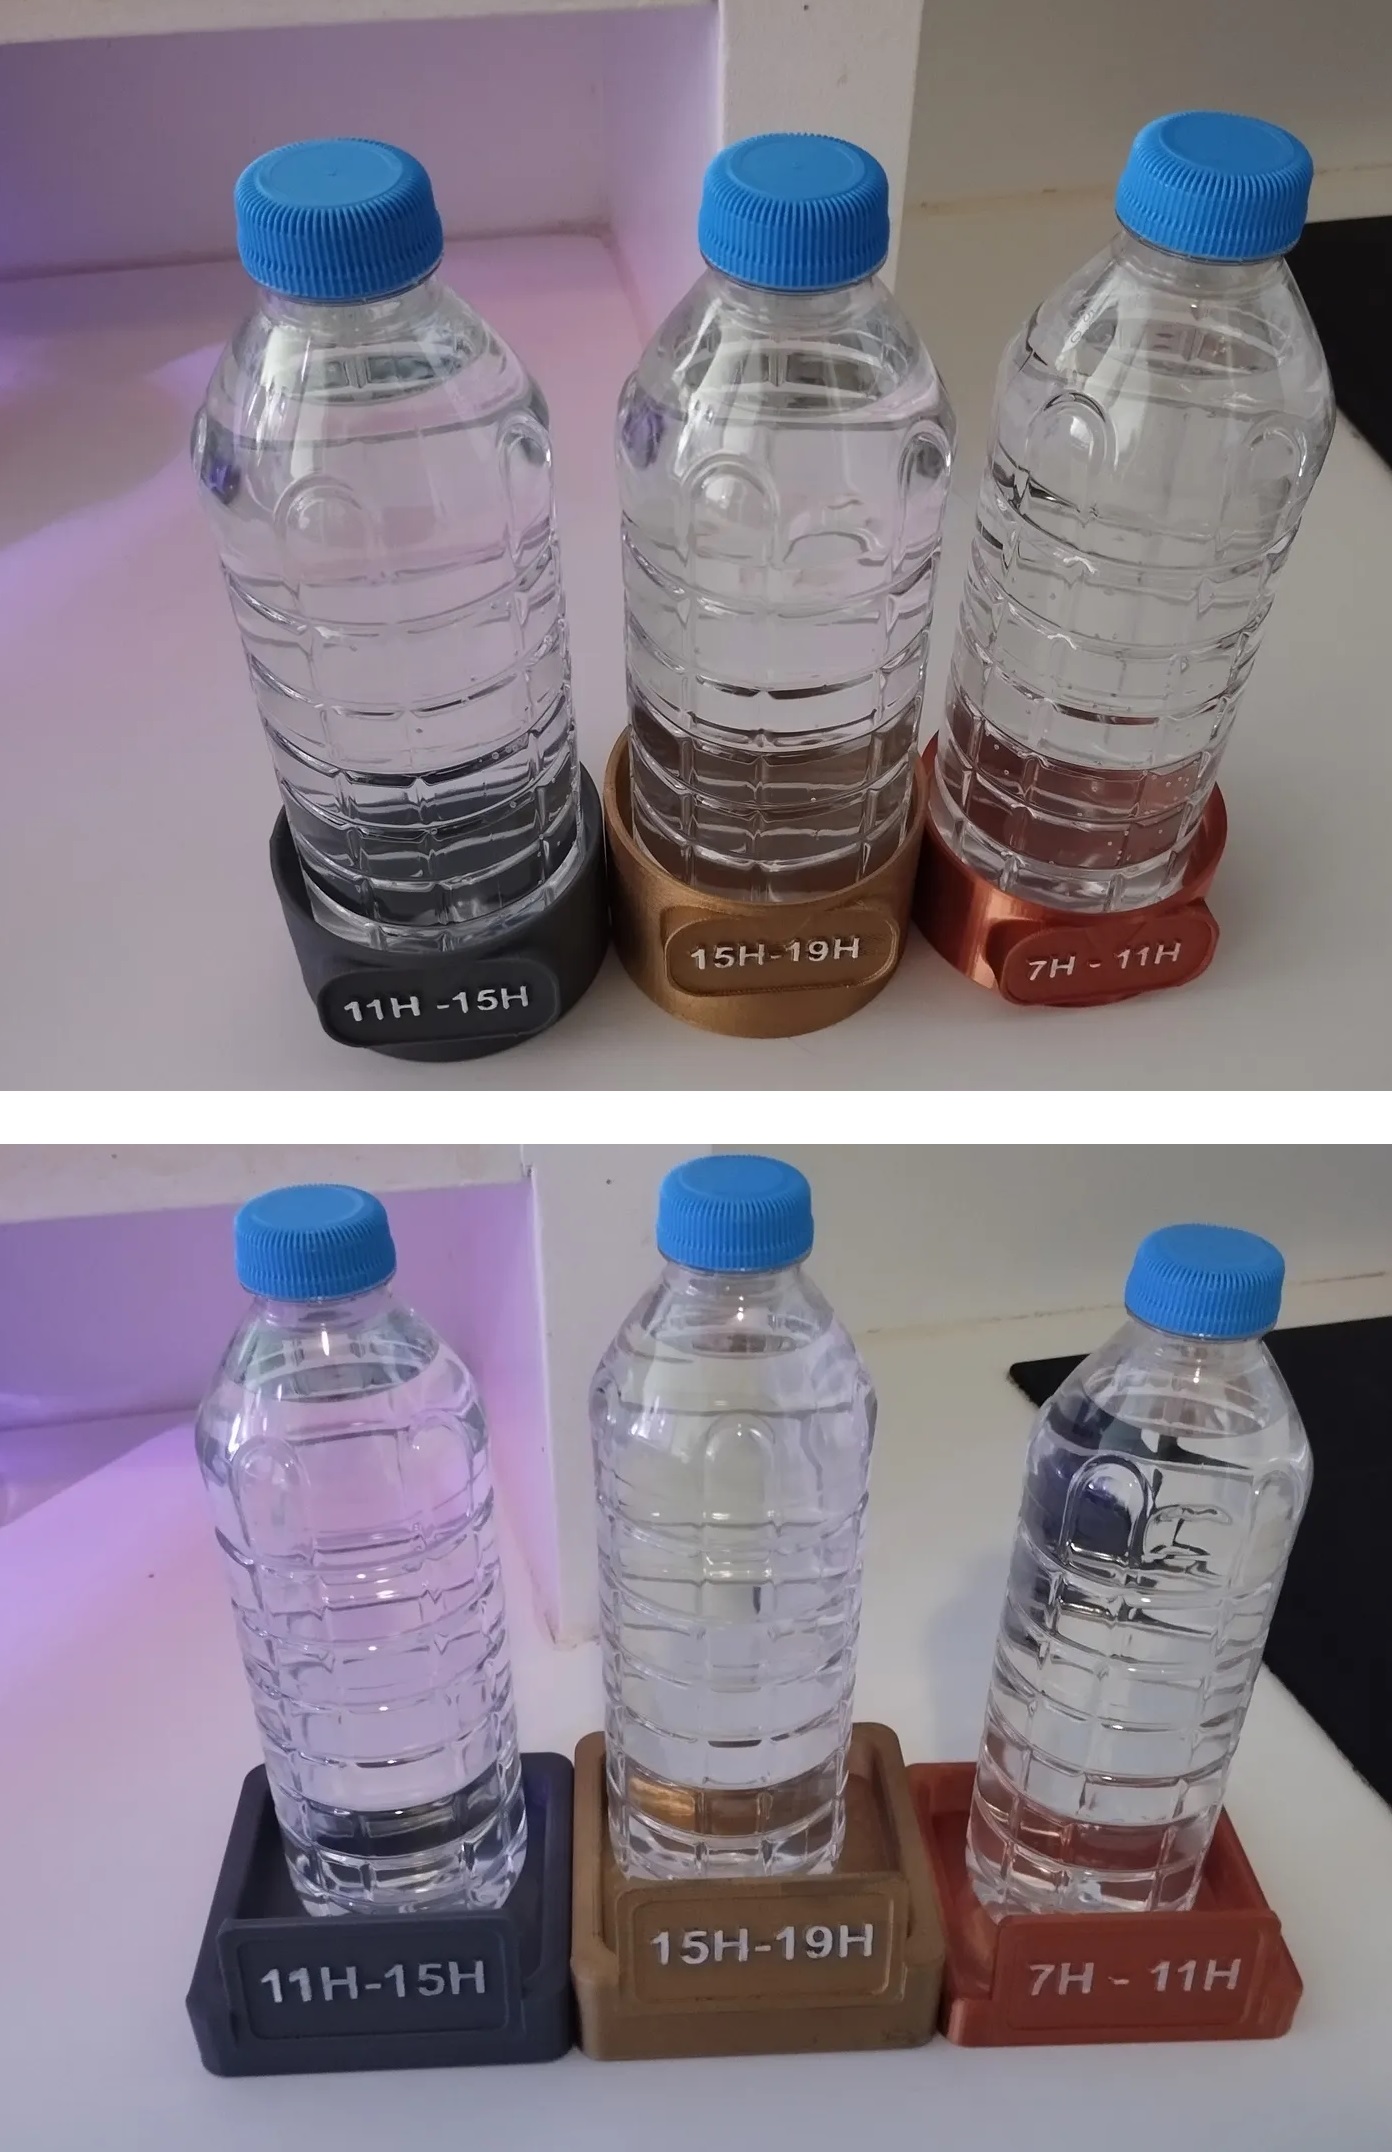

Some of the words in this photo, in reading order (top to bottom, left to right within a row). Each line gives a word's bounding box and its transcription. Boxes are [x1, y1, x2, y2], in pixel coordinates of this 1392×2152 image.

[691, 936, 861, 971] 15H-19H
[1028, 955, 1075, 982] 7H
[1116, 943, 1182, 970] 11H
[342, 995, 421, 1023] 11H
[649, 1923, 874, 1966] 15H-19H
[261, 1960, 486, 2003] 11H-15H
[1028, 1965, 1093, 1998] 7H
[1149, 1959, 1239, 1993] 11H
